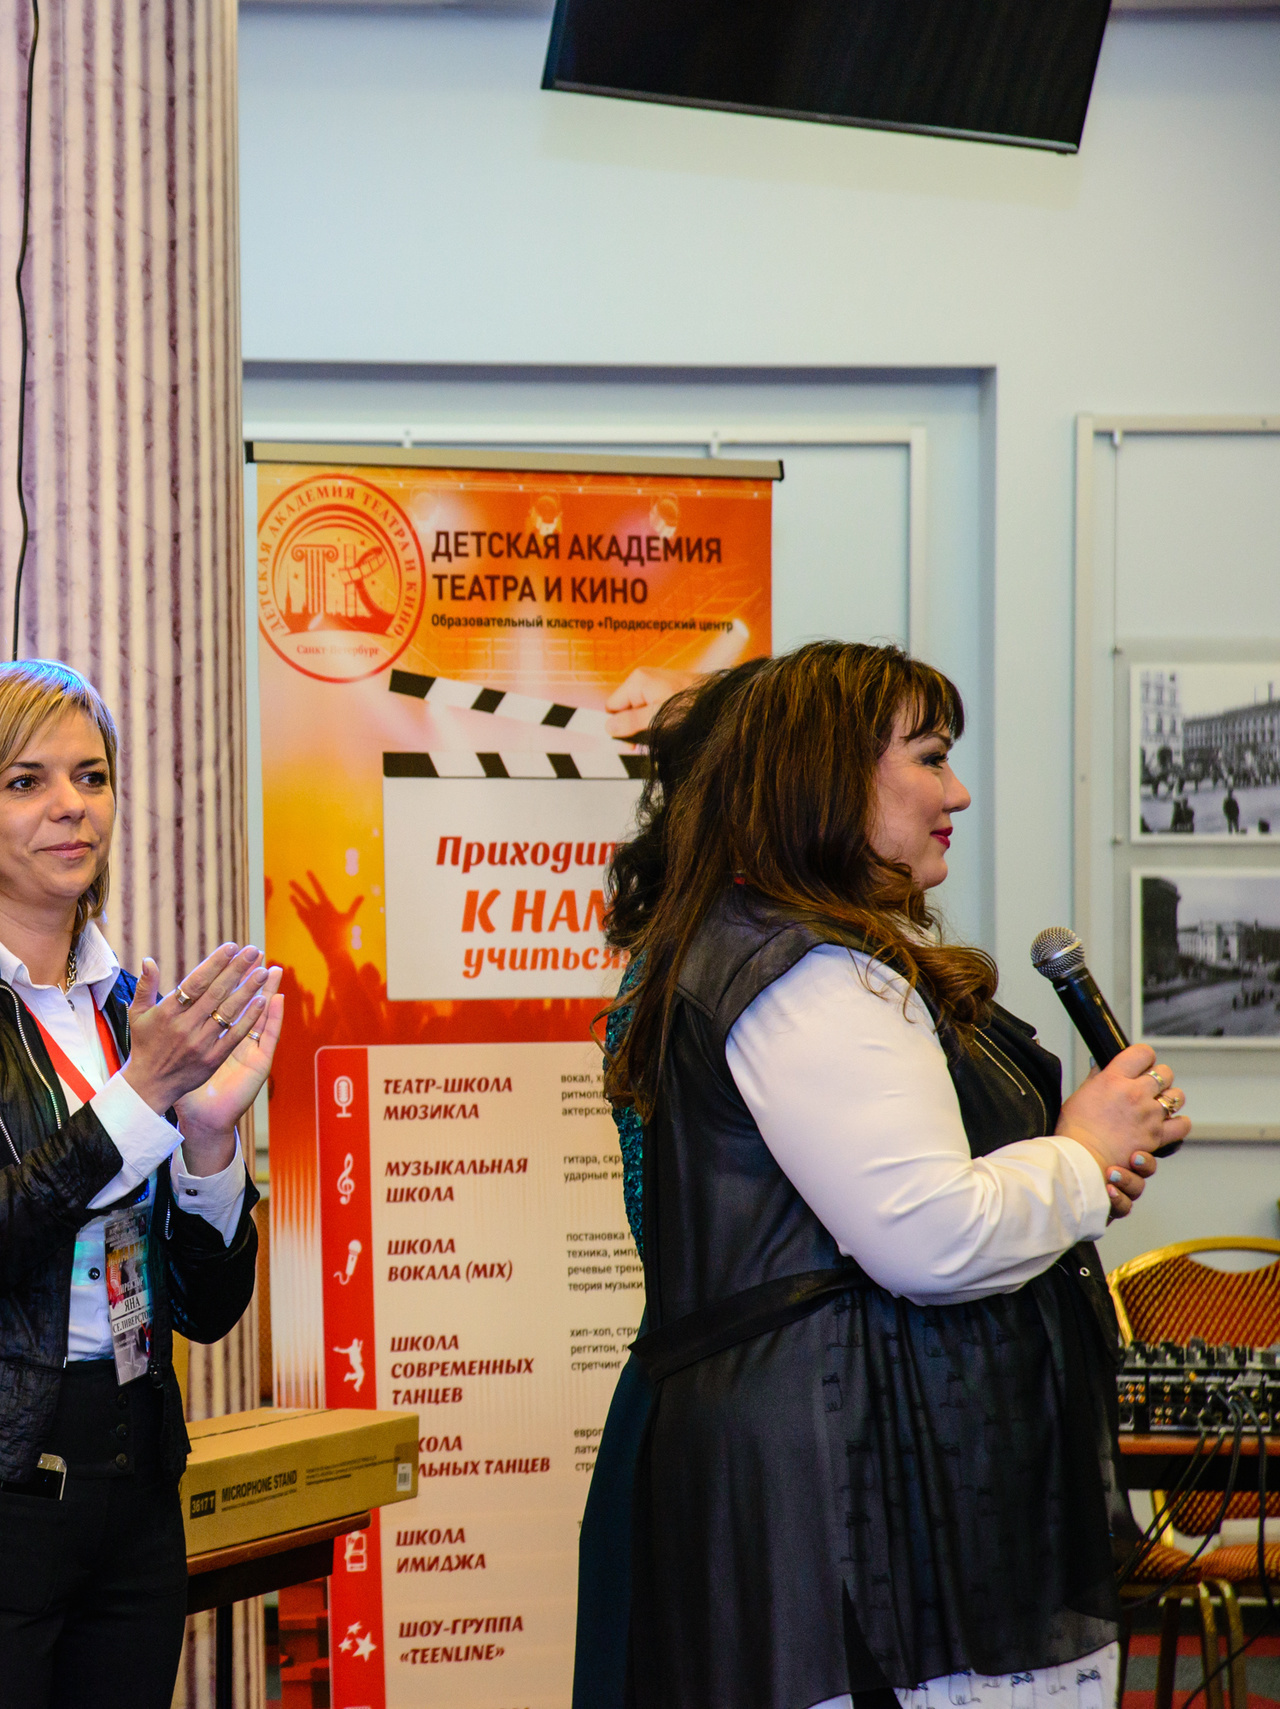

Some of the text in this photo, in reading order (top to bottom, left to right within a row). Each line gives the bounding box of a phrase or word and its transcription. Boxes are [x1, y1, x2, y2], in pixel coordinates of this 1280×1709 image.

[267, 485, 356, 538] АКАДЕМИЯ
[362, 491, 411, 552] ТЕАТРА
[431, 530, 723, 567] ДЕТСКАЯ АКАДЕМИЯ
[258, 541, 286, 633] ДЕТСКАЯ
[431, 573, 648, 604] ТЕАТРА И КИНО
[393, 581, 417, 638] КИНО
[431, 613, 544, 630] Образовательный
[546, 617, 594, 630] кластер
[699, 619, 734, 633] центр
[461, 888, 502, 934] К
[383, 1076, 513, 1095] ТЕАТР-ШКОЛА
[383, 1103, 480, 1121] МЮЗИКЛА
[385, 1157, 528, 1177] МУЗЫКАЛЬНАЯ
[603, 1154, 623, 1166] скр
[563, 1171, 609, 1184] ударные
[385, 1185, 455, 1204] ШКОЛА
[387, 1237, 456, 1256] ШКОЛА
[566, 1232, 625, 1242] постановка
[613, 1247, 640, 1259] импр
[387, 1259, 513, 1283] ВОКАЛА (MIX)
[567, 1265, 612, 1277] речевые
[568, 1282, 602, 1294] теория
[124, 1296, 141, 1312] ЯНА
[616, 1326, 639, 1338] стри
[390, 1334, 460, 1353] ШКОЛА
[390, 1357, 535, 1380] СОВРЕМЕННЫХ
[571, 1360, 622, 1372] стретчинг
[392, 1386, 463, 1406] ТАНЦЕВ
[574, 1444, 599, 1455] лати
[418, 1459, 481, 1478] ЛЬНЫХ
[484, 1456, 551, 1475] ТАНЦЕВ
[221, 1475, 273, 1503] MICROPHONE
[273, 1469, 298, 1489] STAND
[395, 1527, 466, 1547] ШКОЛА
[396, 1553, 487, 1574] ИМИДЖА
[398, 1615, 524, 1639] ШОУ-ГРУППА
